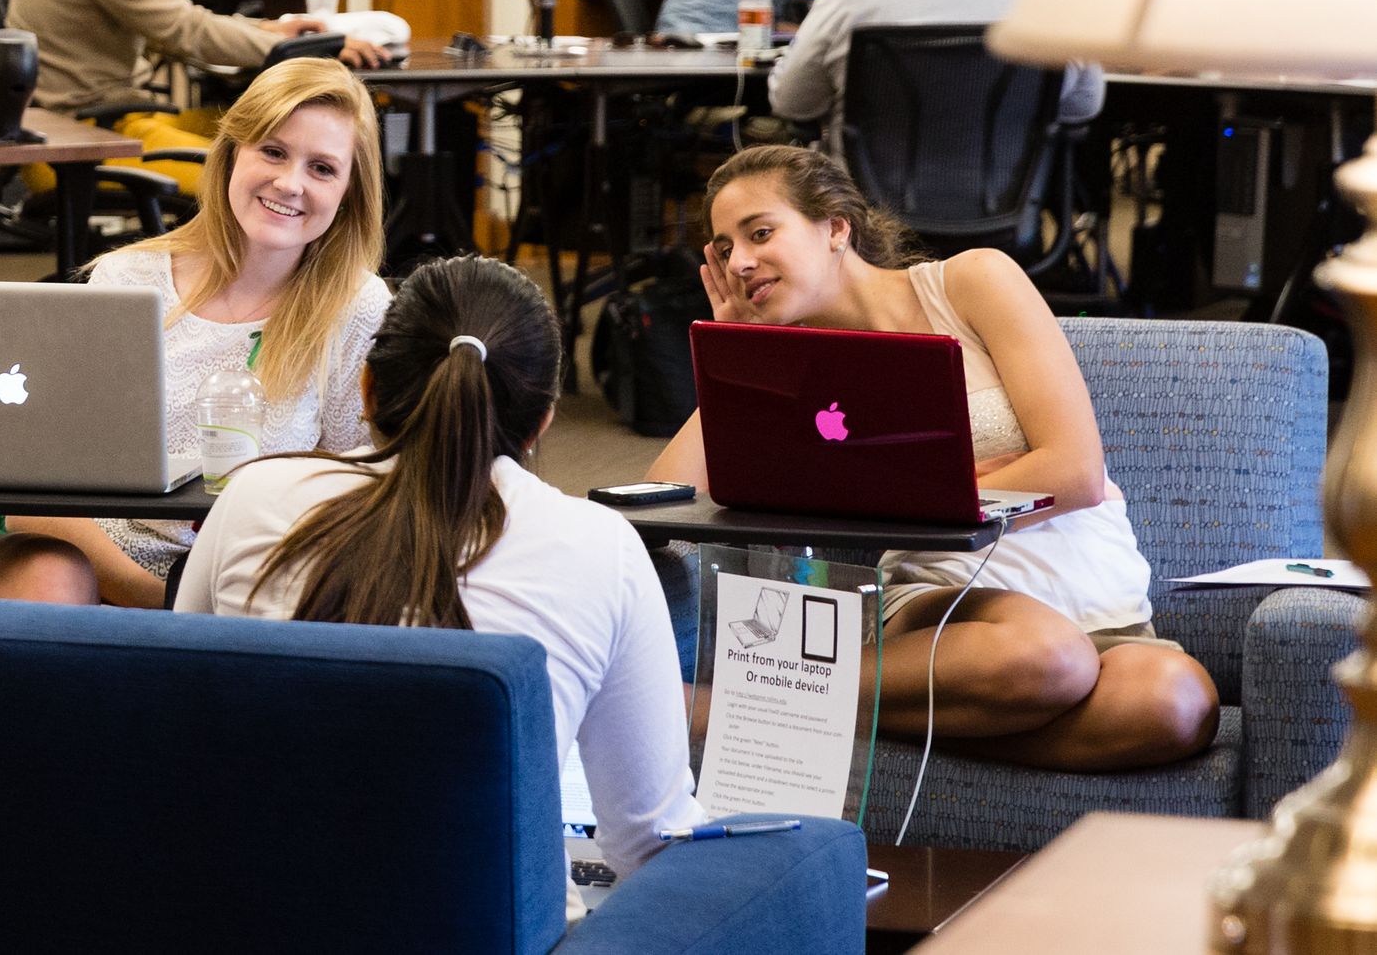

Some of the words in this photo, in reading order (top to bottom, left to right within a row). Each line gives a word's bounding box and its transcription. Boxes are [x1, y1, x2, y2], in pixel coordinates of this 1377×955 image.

[727, 648, 750, 663] Print
[752, 652, 775, 667] from
[777, 659, 799, 671] your
[801, 661, 832, 678] laptop
[746, 670, 758, 683] Or
[760, 675, 793, 689] mobile
[795, 678, 829, 695] device!
